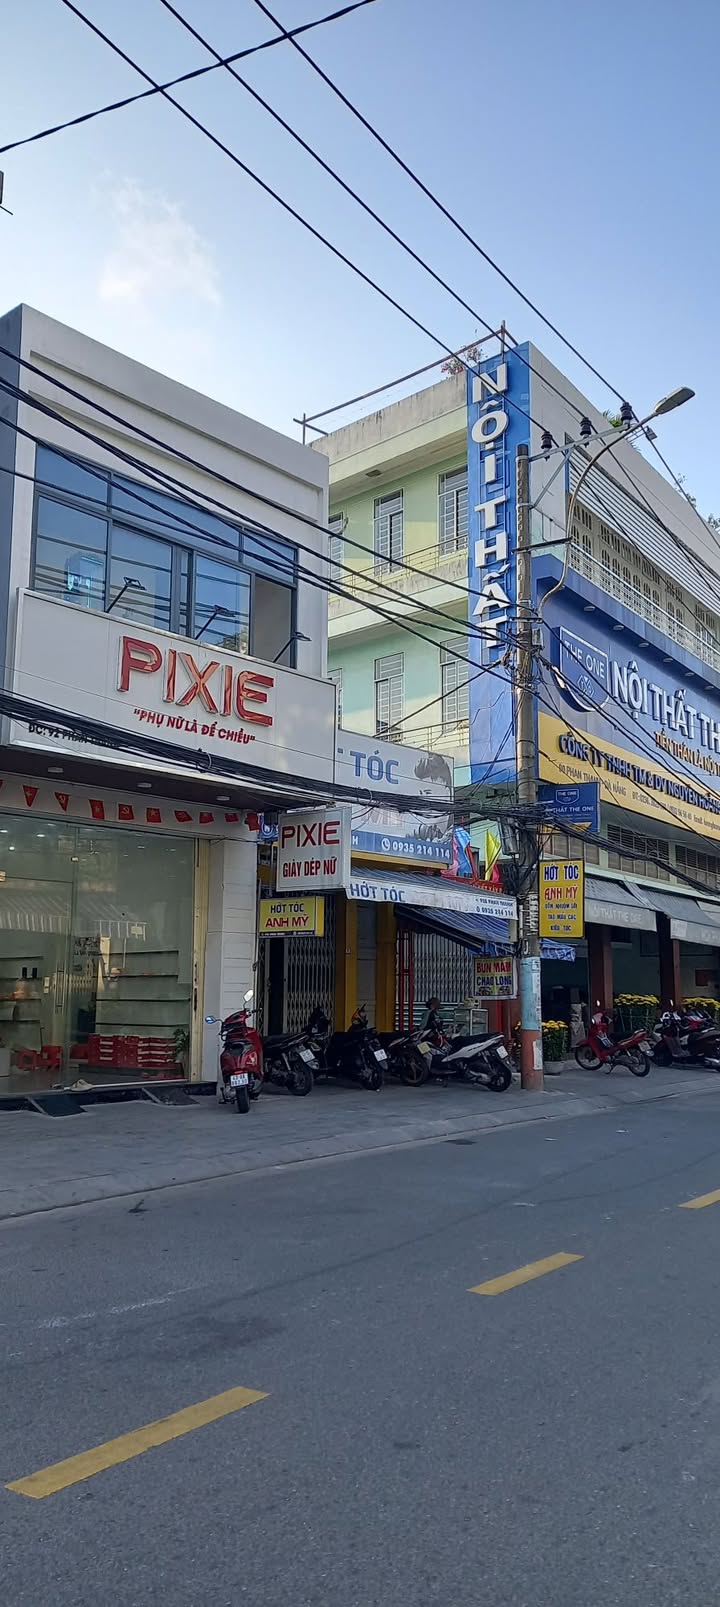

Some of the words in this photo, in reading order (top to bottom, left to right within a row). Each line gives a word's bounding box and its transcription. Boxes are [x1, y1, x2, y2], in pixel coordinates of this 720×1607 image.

[471, 362, 509, 484] NỘI
[472, 495, 512, 648] THẤT
[564, 640, 583, 663] THE
[586, 654, 605, 679] ONE
[116, 635, 275, 727] PIXIE
[610, 660, 648, 719] NỘI
[648, 683, 697, 739] THẤT
[167, 716, 184, 729] NỮ
[185, 720, 197, 733] LÀ
[201, 721, 218, 737] ĐỂ
[350, 750, 399, 785] TÓC
[631, 764, 645, 785] TM
[646, 770, 653, 788] &
[652, 774, 666, 792] DV
[281, 821, 340, 848] PIXIE
[392, 841, 414, 853] 0935
[417, 844, 433, 856] 214
[435, 847, 450, 859] 114
[283, 858, 302, 877] GIÀY
[304, 857, 321, 876] DÉP
[323, 856, 337, 875] NỮ
[544, 863, 558, 880] HỚT
[563, 862, 579, 880] TÓC
[350, 881, 377, 899] HỚT
[381, 886, 406, 902] TÓC
[544, 887, 562, 900] ANH
[270, 902, 287, 913] HỚT
[288, 902, 304, 913] TÓC
[265, 917, 289, 928] ANH
